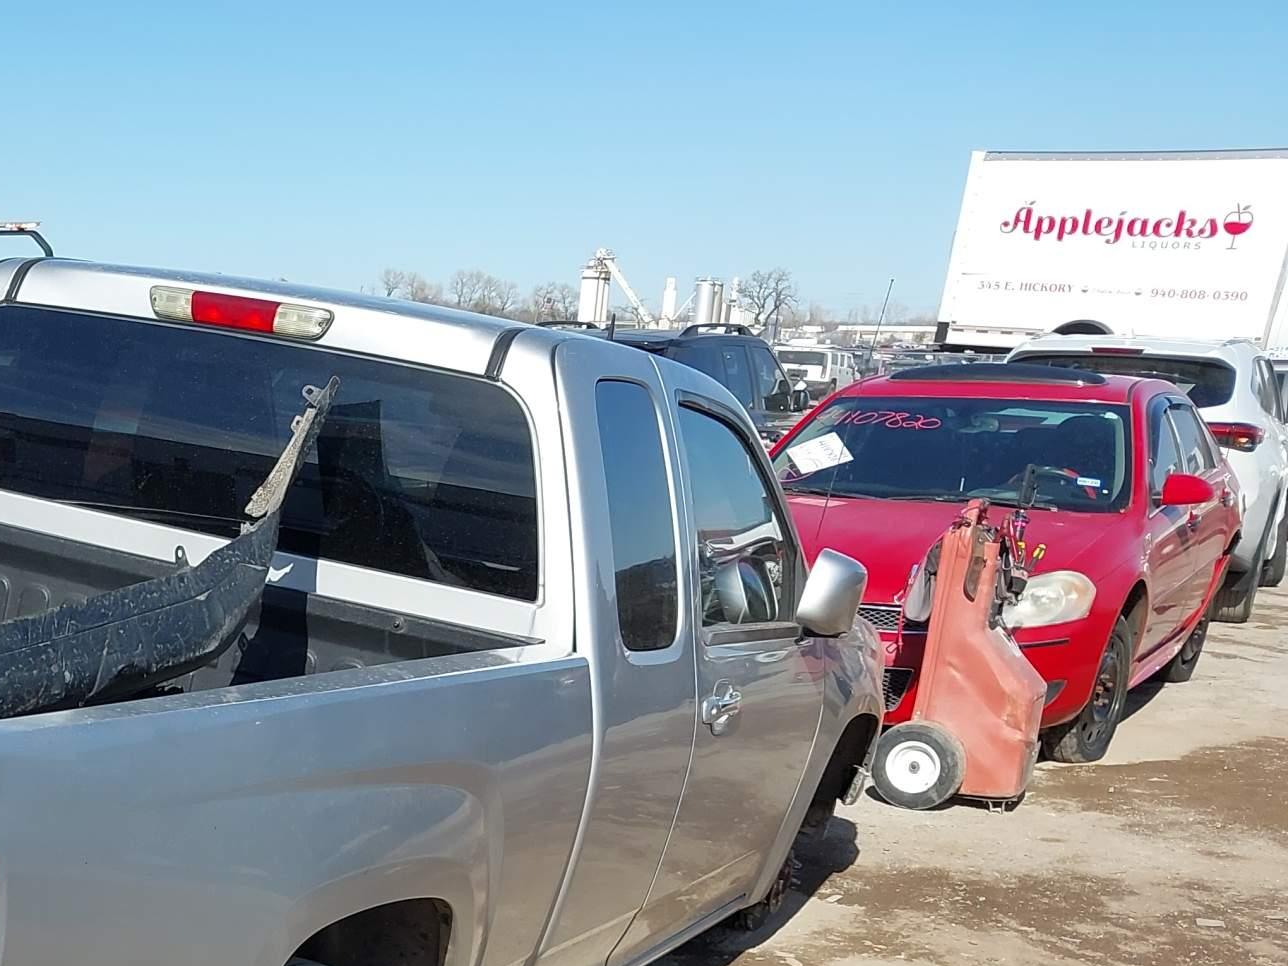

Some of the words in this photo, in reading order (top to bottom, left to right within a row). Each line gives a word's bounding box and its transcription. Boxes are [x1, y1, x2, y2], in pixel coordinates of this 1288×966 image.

[1000, 202, 1219, 245] Applejacks
[1132, 241, 1202, 251] LIQUORS
[1019, 282, 1073, 294] HICKORY
